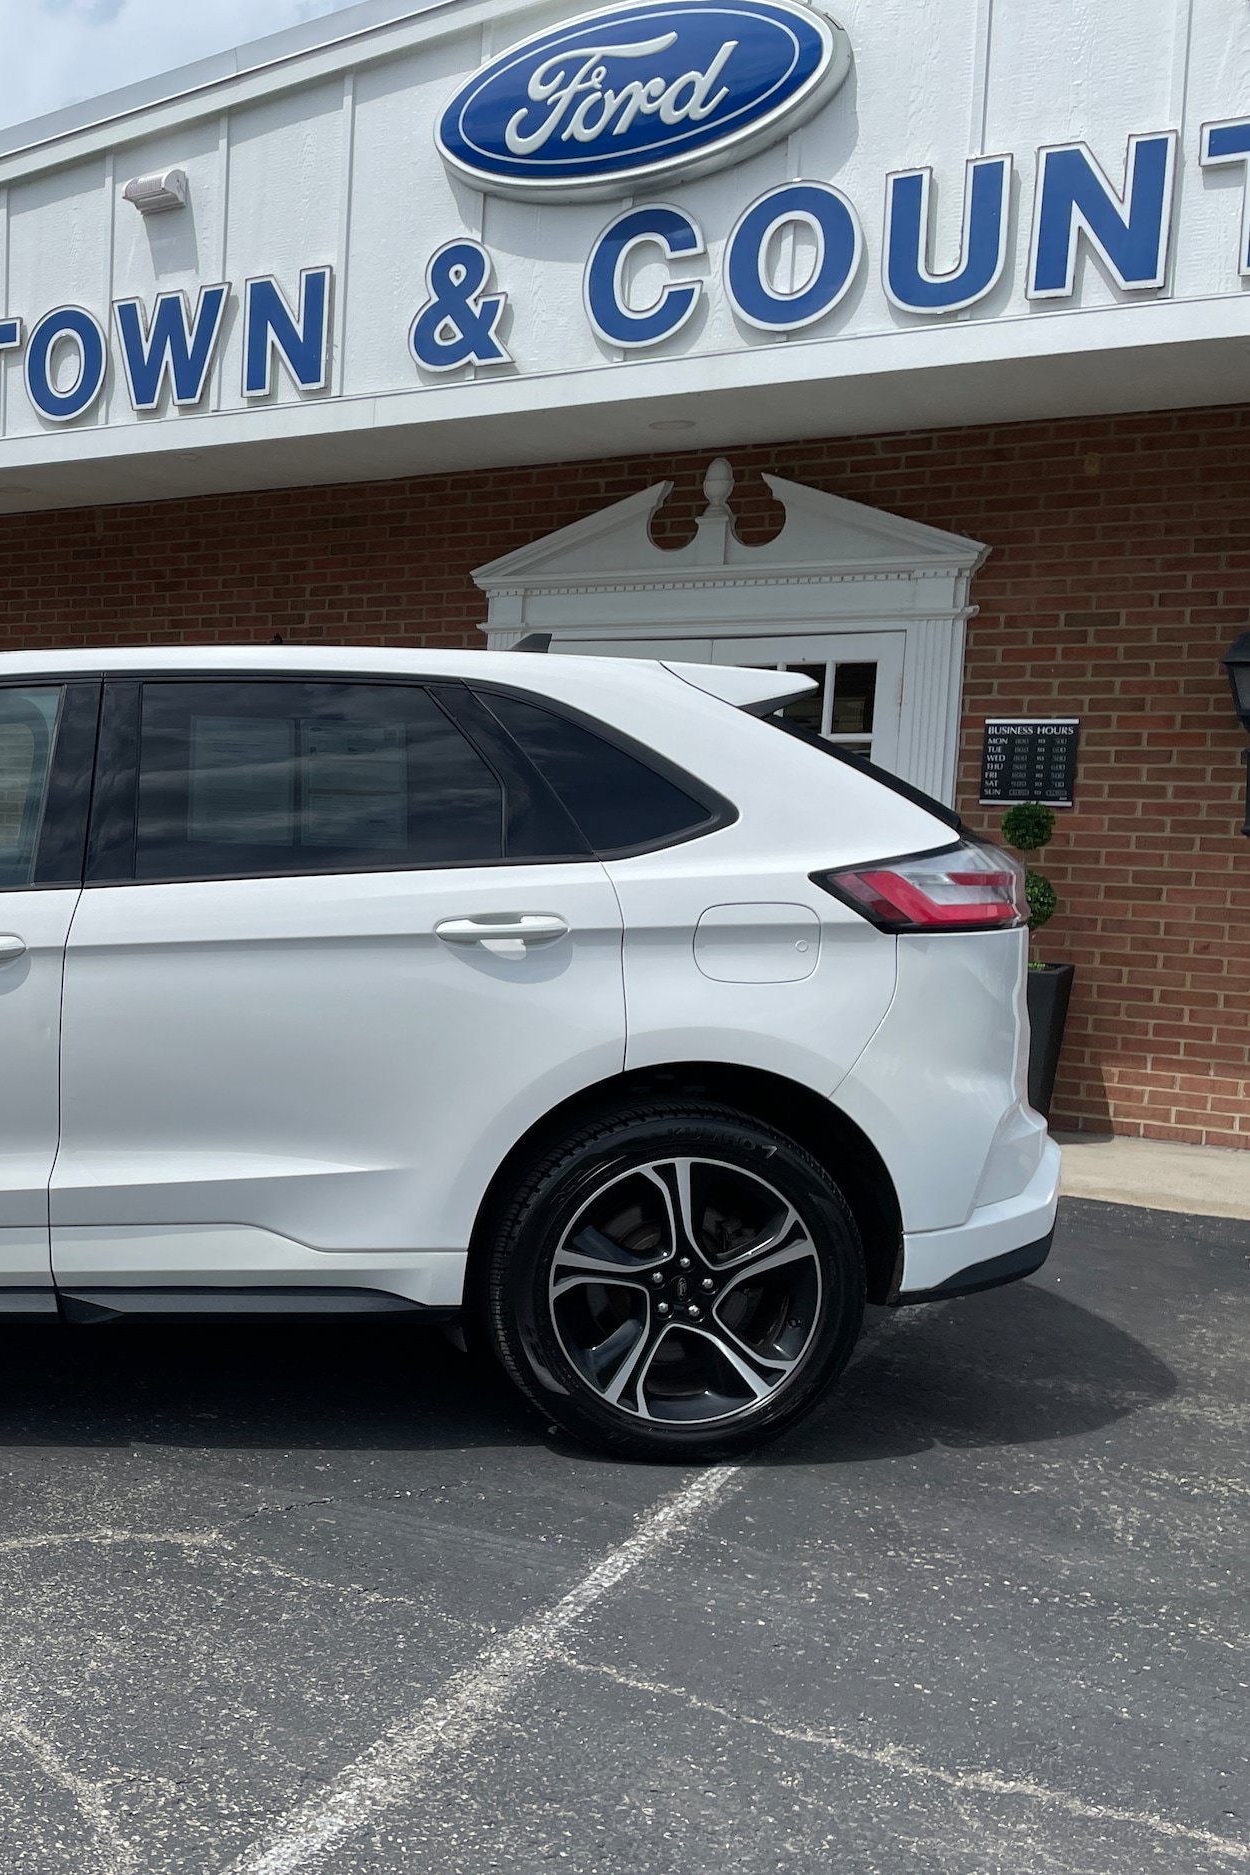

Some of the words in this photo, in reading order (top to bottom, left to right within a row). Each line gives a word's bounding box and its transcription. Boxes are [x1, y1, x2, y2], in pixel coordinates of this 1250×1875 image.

[505, 31, 739, 155] Ford
[408, 237, 515, 374] &
[988, 726, 1033, 735] BUSINESS
[1036, 726, 1074, 735] HOURS
